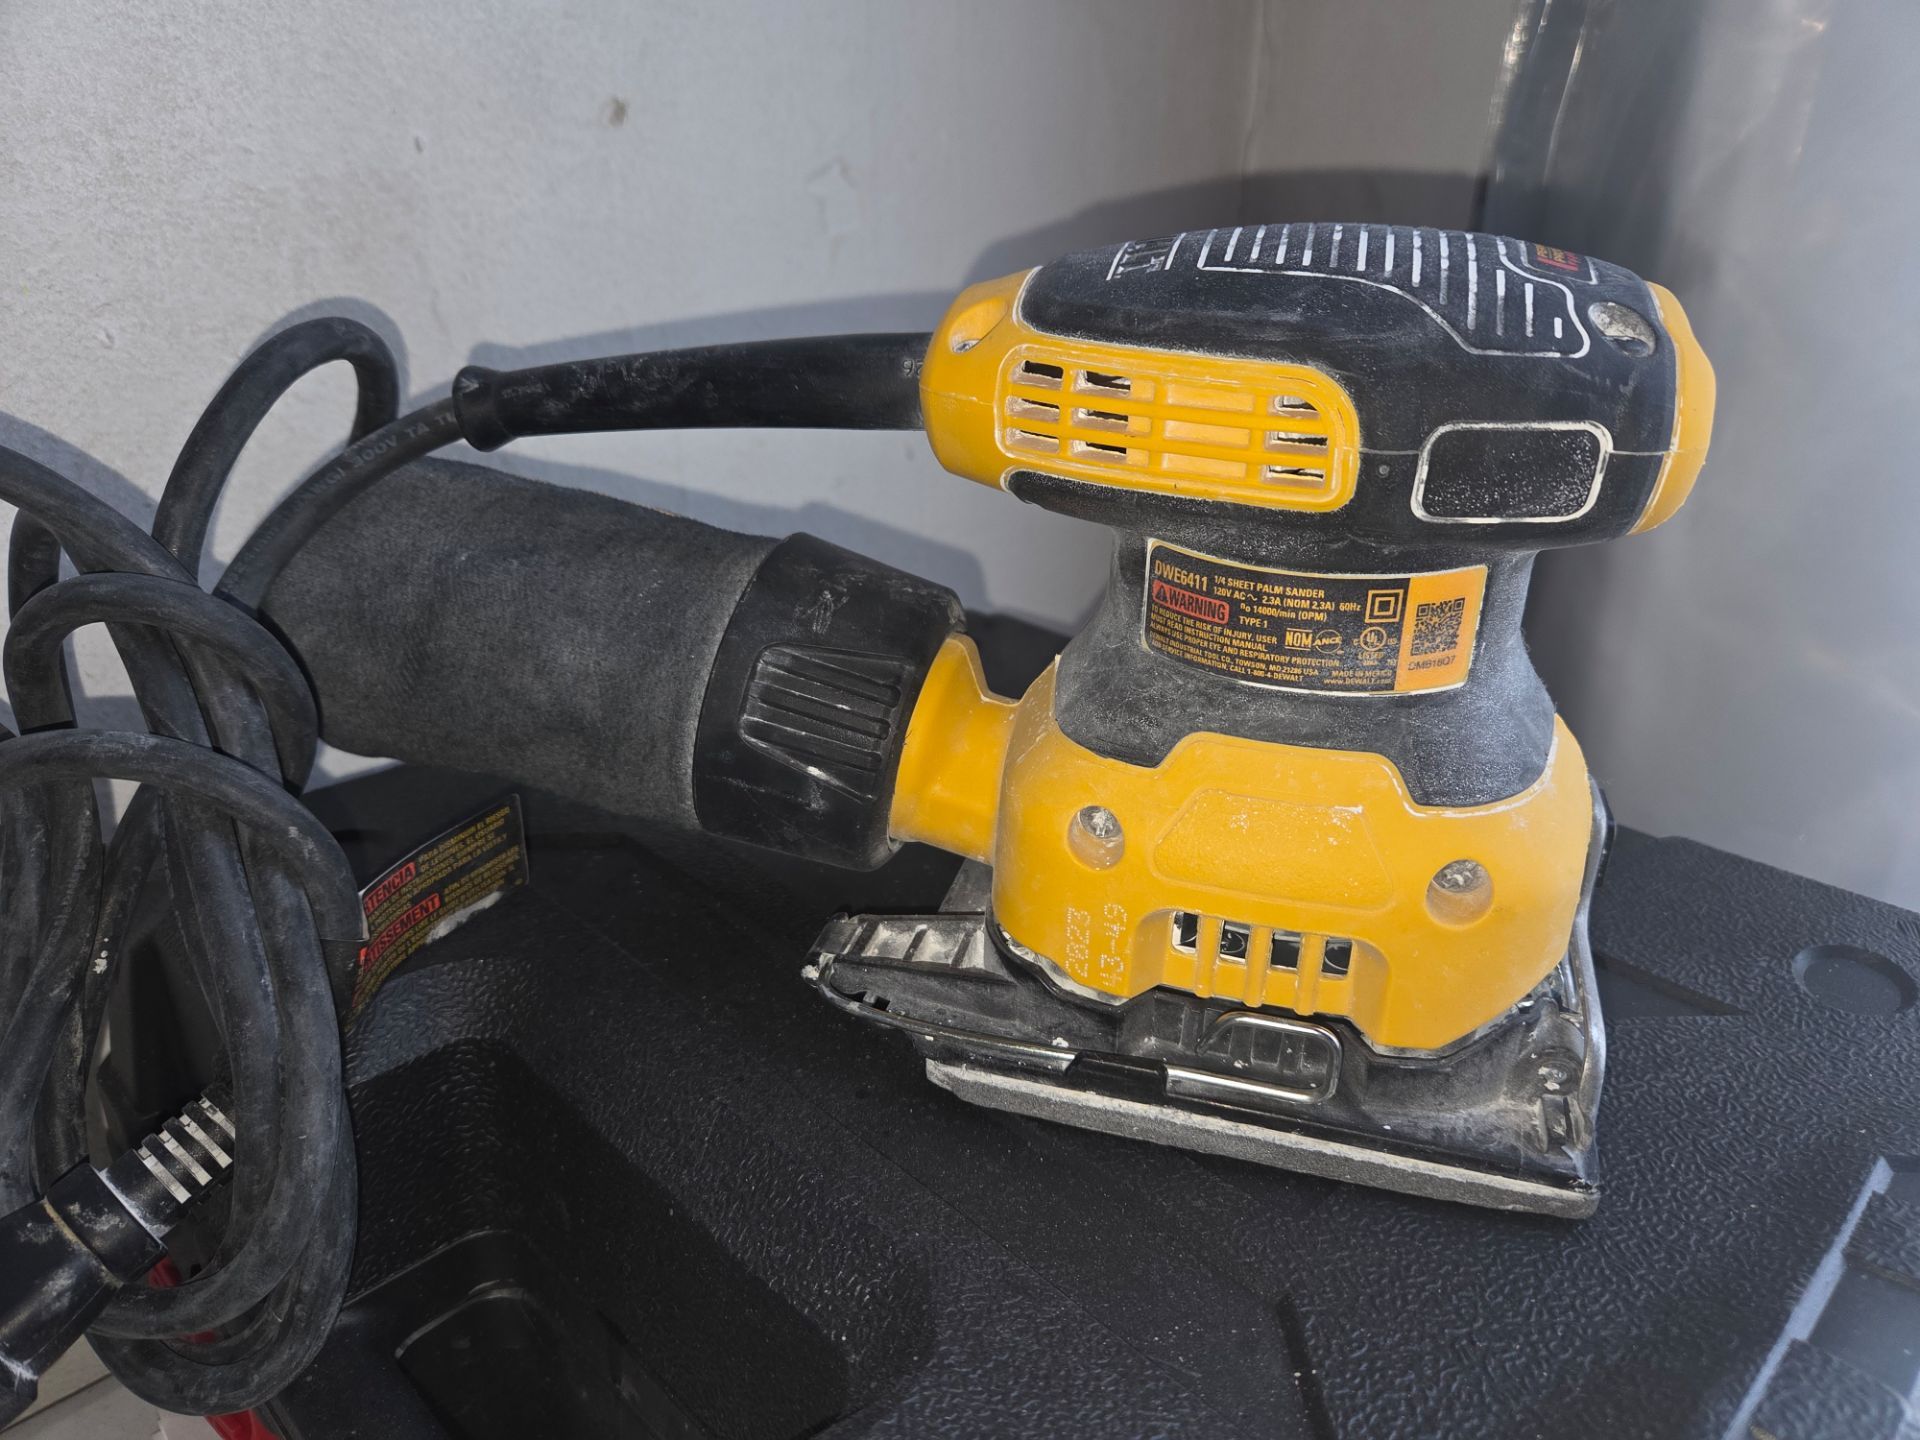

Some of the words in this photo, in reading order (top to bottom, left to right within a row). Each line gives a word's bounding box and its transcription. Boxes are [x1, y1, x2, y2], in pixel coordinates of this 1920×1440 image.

[1154, 560, 1208, 591] DWE6411
[1214, 576, 1226, 586] 1/4
[1228, 578, 1255, 590] SHEET
[1257, 583, 1283, 594] PALM
[1285, 587, 1325, 598] SANDER
[1169, 589, 1226, 621] WARNING
[1214, 587, 1231, 597] 120V
[1262, 596, 1281, 606] 2.3A
[1283, 598, 1309, 609] (NOM
[1312, 601, 1334, 611] 2.3A)
[1339, 602, 1361, 612] 60Hz
[1239, 616, 1263, 627] TYPE
[1253, 606, 1296, 618] 14000/min
[1298, 611, 1327, 622] (OPM)
[1167, 619, 1183, 631] READ
[1232, 639, 1268, 651] MANUAL
[1183, 617, 1194, 626] THE
[1196, 621, 1212, 631] RISK
[1256, 634, 1277, 644] USER
[1285, 631, 1312, 647] NOM
[1312, 637, 1342, 646] ANCE
[1184, 634, 1208, 647] PROPER
[1209, 642, 1221, 651] EYE
[1223, 646, 1238, 655] AND
[1239, 649, 1290, 663] RESPIRATORY
[1230, 665, 1245, 674] CALL
[1100, 903, 1128, 986] 43-49
